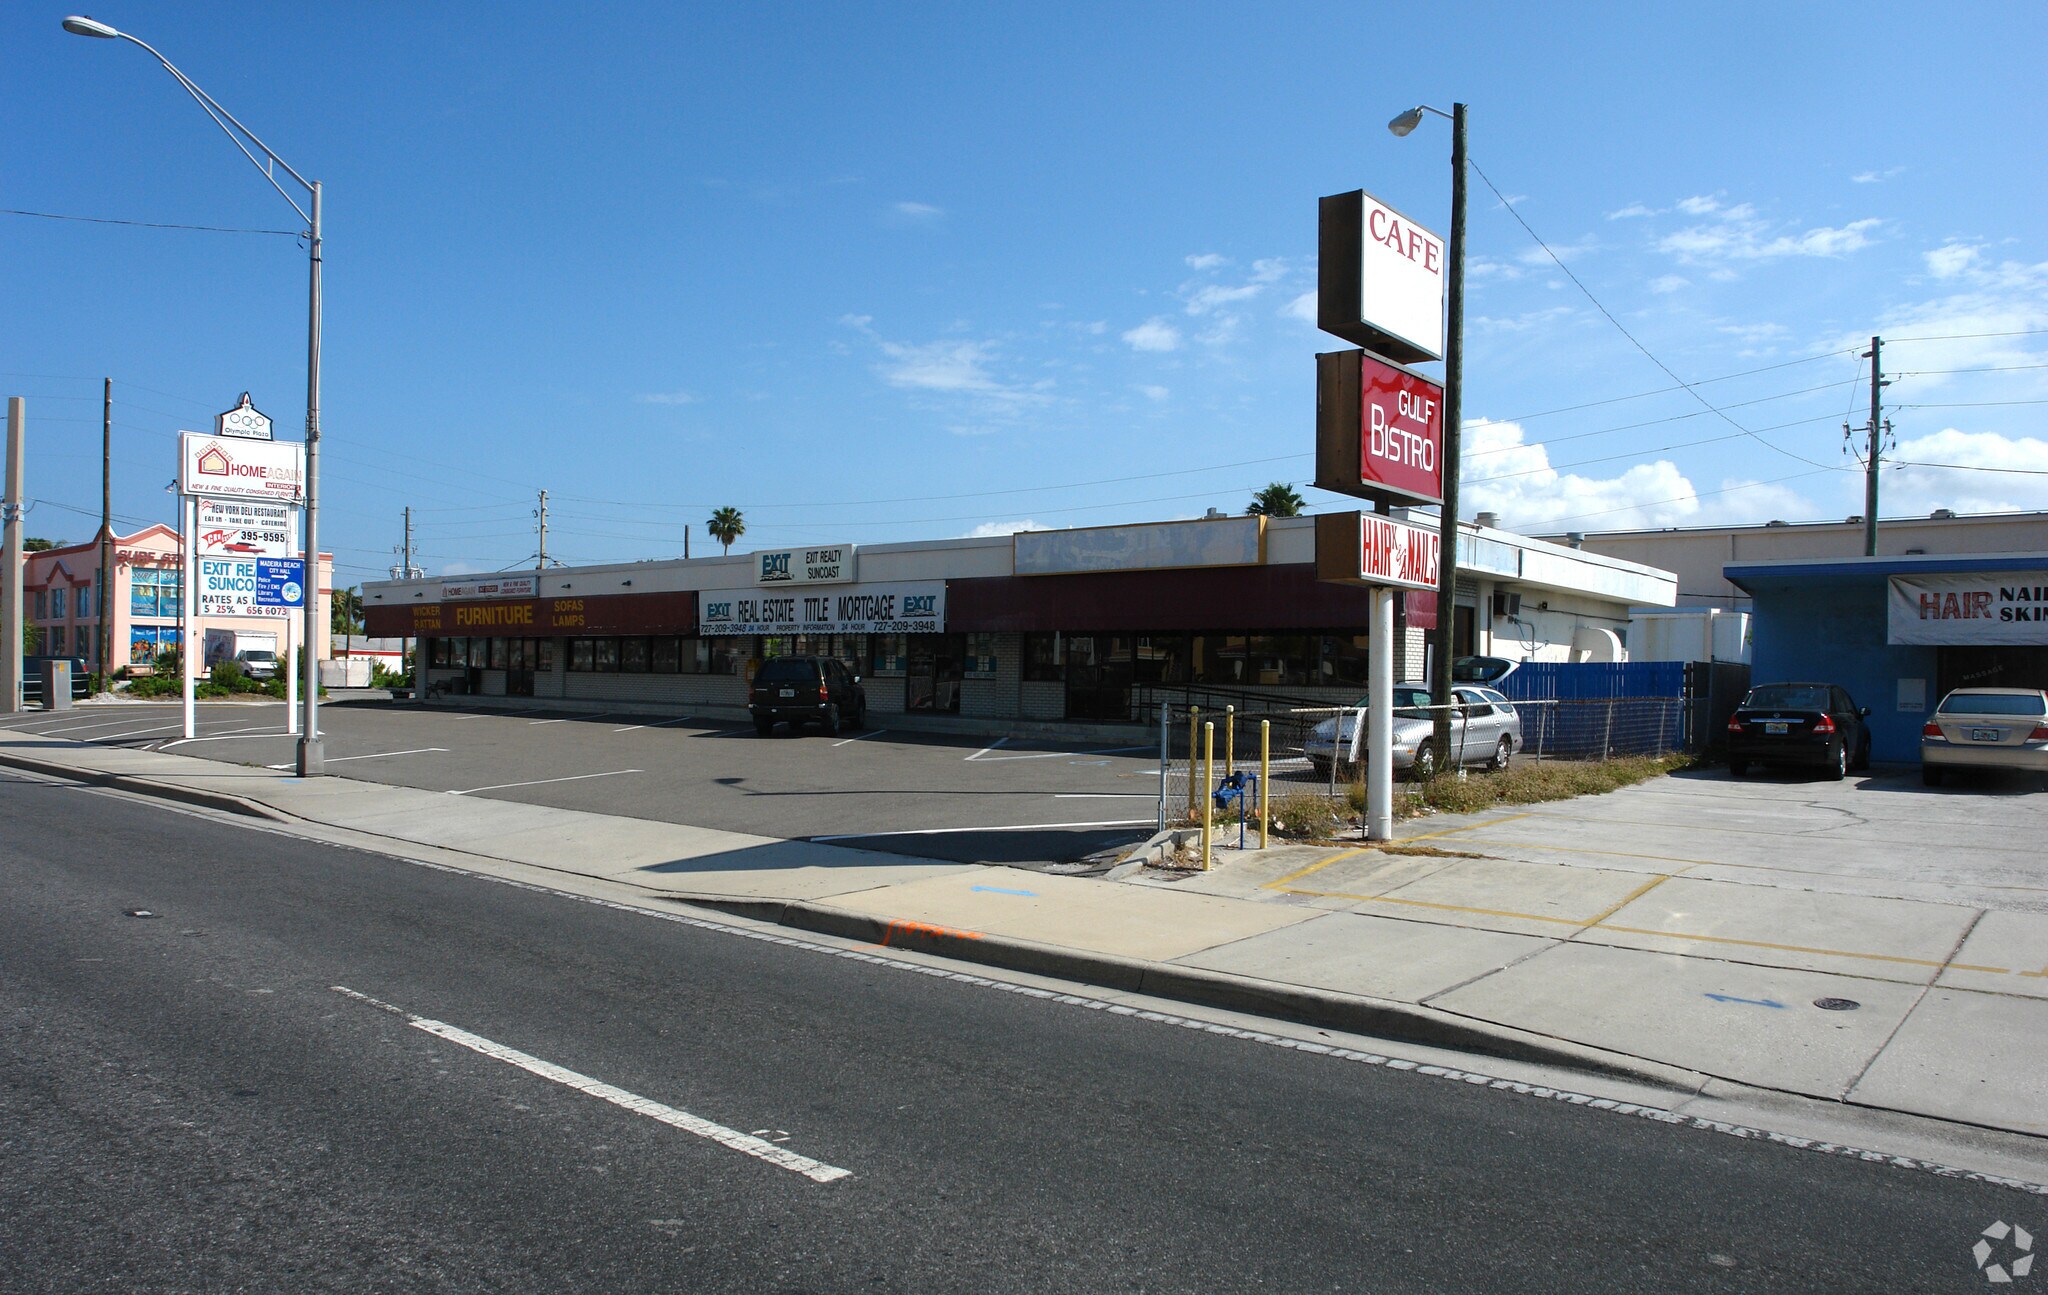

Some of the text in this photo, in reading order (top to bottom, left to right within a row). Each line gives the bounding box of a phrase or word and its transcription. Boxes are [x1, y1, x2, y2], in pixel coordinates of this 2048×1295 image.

[1370, 208, 1438, 275] CAFE
[1398, 389, 1434, 424] GULF
[1371, 403, 1434, 472] BISTRO
[212, 504, 224, 513] NEW
[225, 506, 240, 515] YORK
[241, 507, 252, 516] DELI
[254, 507, 286, 518] RESTAURANT
[241, 531, 285, 542] 395-9595
[118, 550, 156, 562] SURF
[806, 550, 842, 564] EXIT REALTY
[1363, 518, 1391, 577] HAIR
[1407, 529, 1438, 585] NAILS
[203, 562, 232, 575] EXIT
[807, 567, 840, 579] SUNCOAST
[208, 576, 256, 591] SUNCO
[202, 595, 232, 604] RATES
[236, 596, 248, 604] AS
[554, 600, 584, 612] SOFAS
[1920, 591, 1993, 620] HAIR
[204, 605, 287, 616] 5 25% 656 6073
[412, 606, 440, 617] WICKER
[456, 605, 533, 626] FURNITURE
[738, 600, 760, 623] REAL
[762, 598, 795, 622] ESTATE
[804, 597, 829, 622] TITLE
[838, 595, 895, 621] MORTGAGE
[414, 619, 441, 629] RATTAN
[552, 615, 585, 627] LAMPS
[701, 624, 746, 633] 727-209-3948
[873, 622, 935, 631] 727-209-3948
[1962, 664, 2004, 680] MASSAGE
